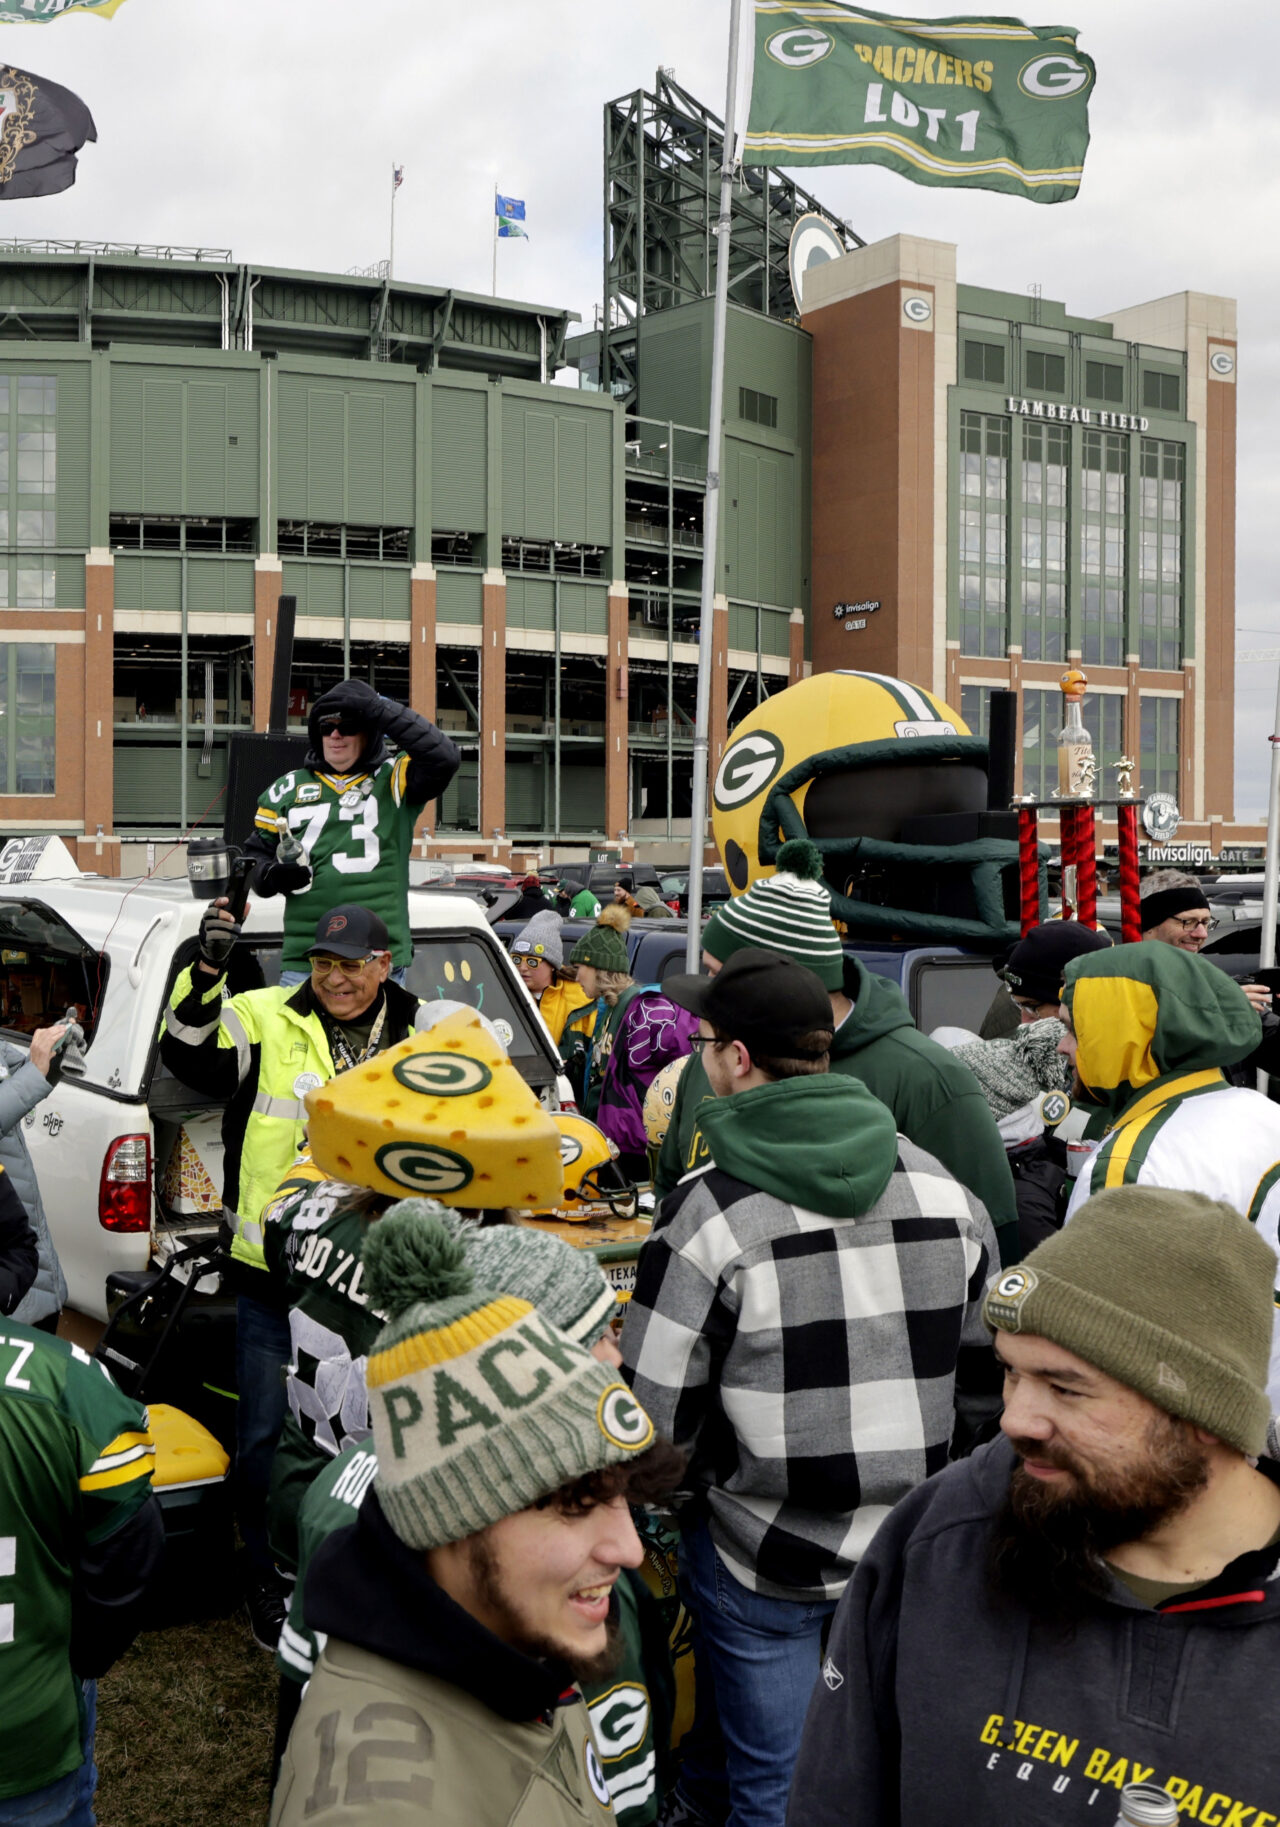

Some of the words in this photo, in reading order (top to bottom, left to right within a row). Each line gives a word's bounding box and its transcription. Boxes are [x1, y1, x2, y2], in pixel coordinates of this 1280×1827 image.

[854, 44, 994, 92] PACKERS
[864, 82, 947, 142] LOT
[955, 109, 980, 152] 1
[1006, 397, 1092, 425] LAMBEAU
[1099, 409, 1150, 433] FIELD
[845, 600, 880, 614] invisalign
[597, 853, 609, 863] LOT
[1147, 842, 1212, 867] invisalign
[1220, 849, 1250, 862] GATE
[1044, 1095, 1065, 1120] 15
[609, 1265, 637, 1282] TEXA
[304, 1700, 435, 1819] 12
[1083, 1747, 1155, 1790] BAY
